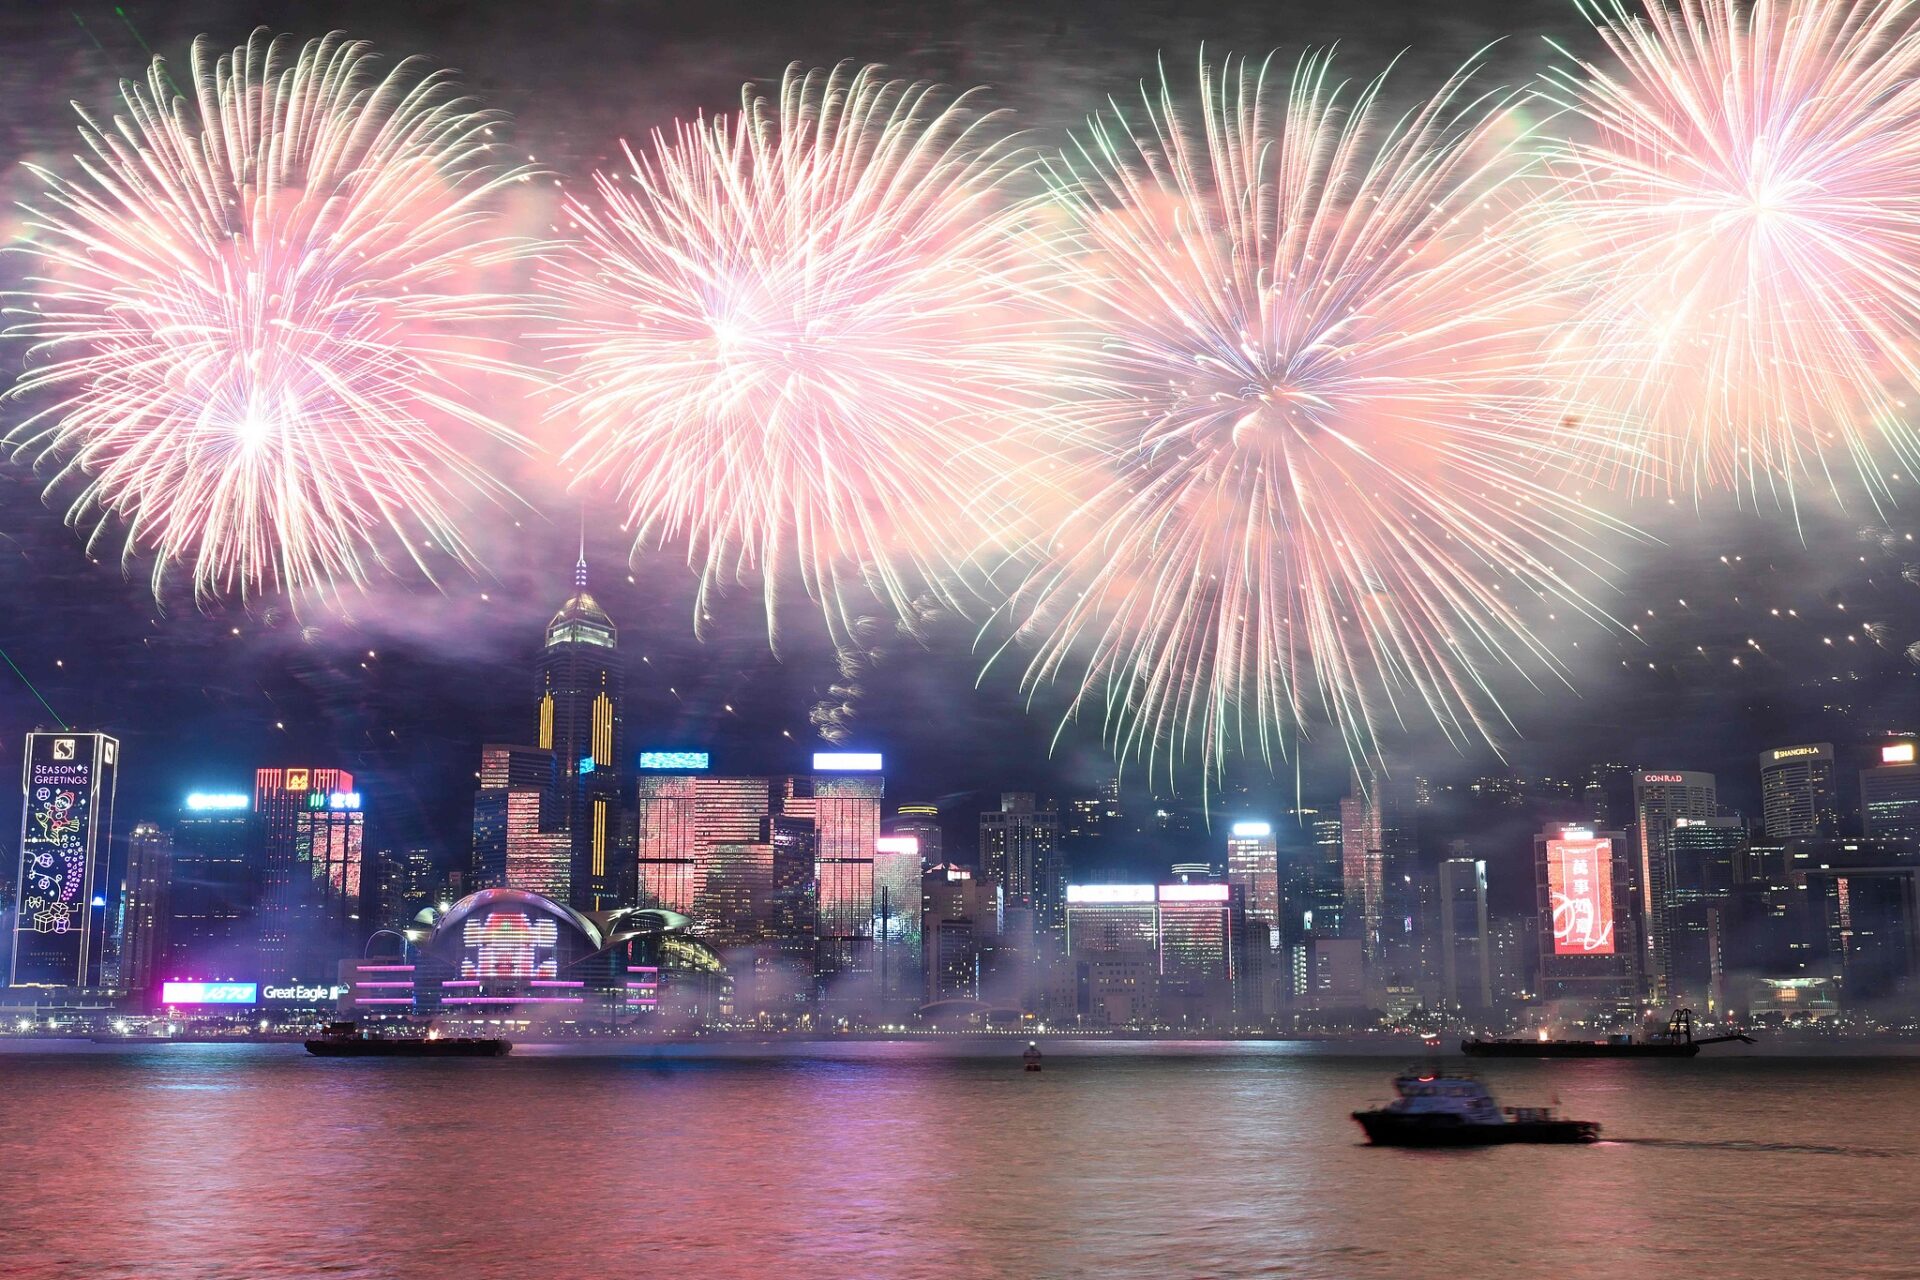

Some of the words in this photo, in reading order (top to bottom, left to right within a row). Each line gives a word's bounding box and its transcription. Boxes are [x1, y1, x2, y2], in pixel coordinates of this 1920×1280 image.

[34, 775, 88, 785] GREETINGS
[1644, 774, 1683, 782] CONRAD
[263, 985, 296, 999] Great
[296, 985, 328, 1002] Eagle
